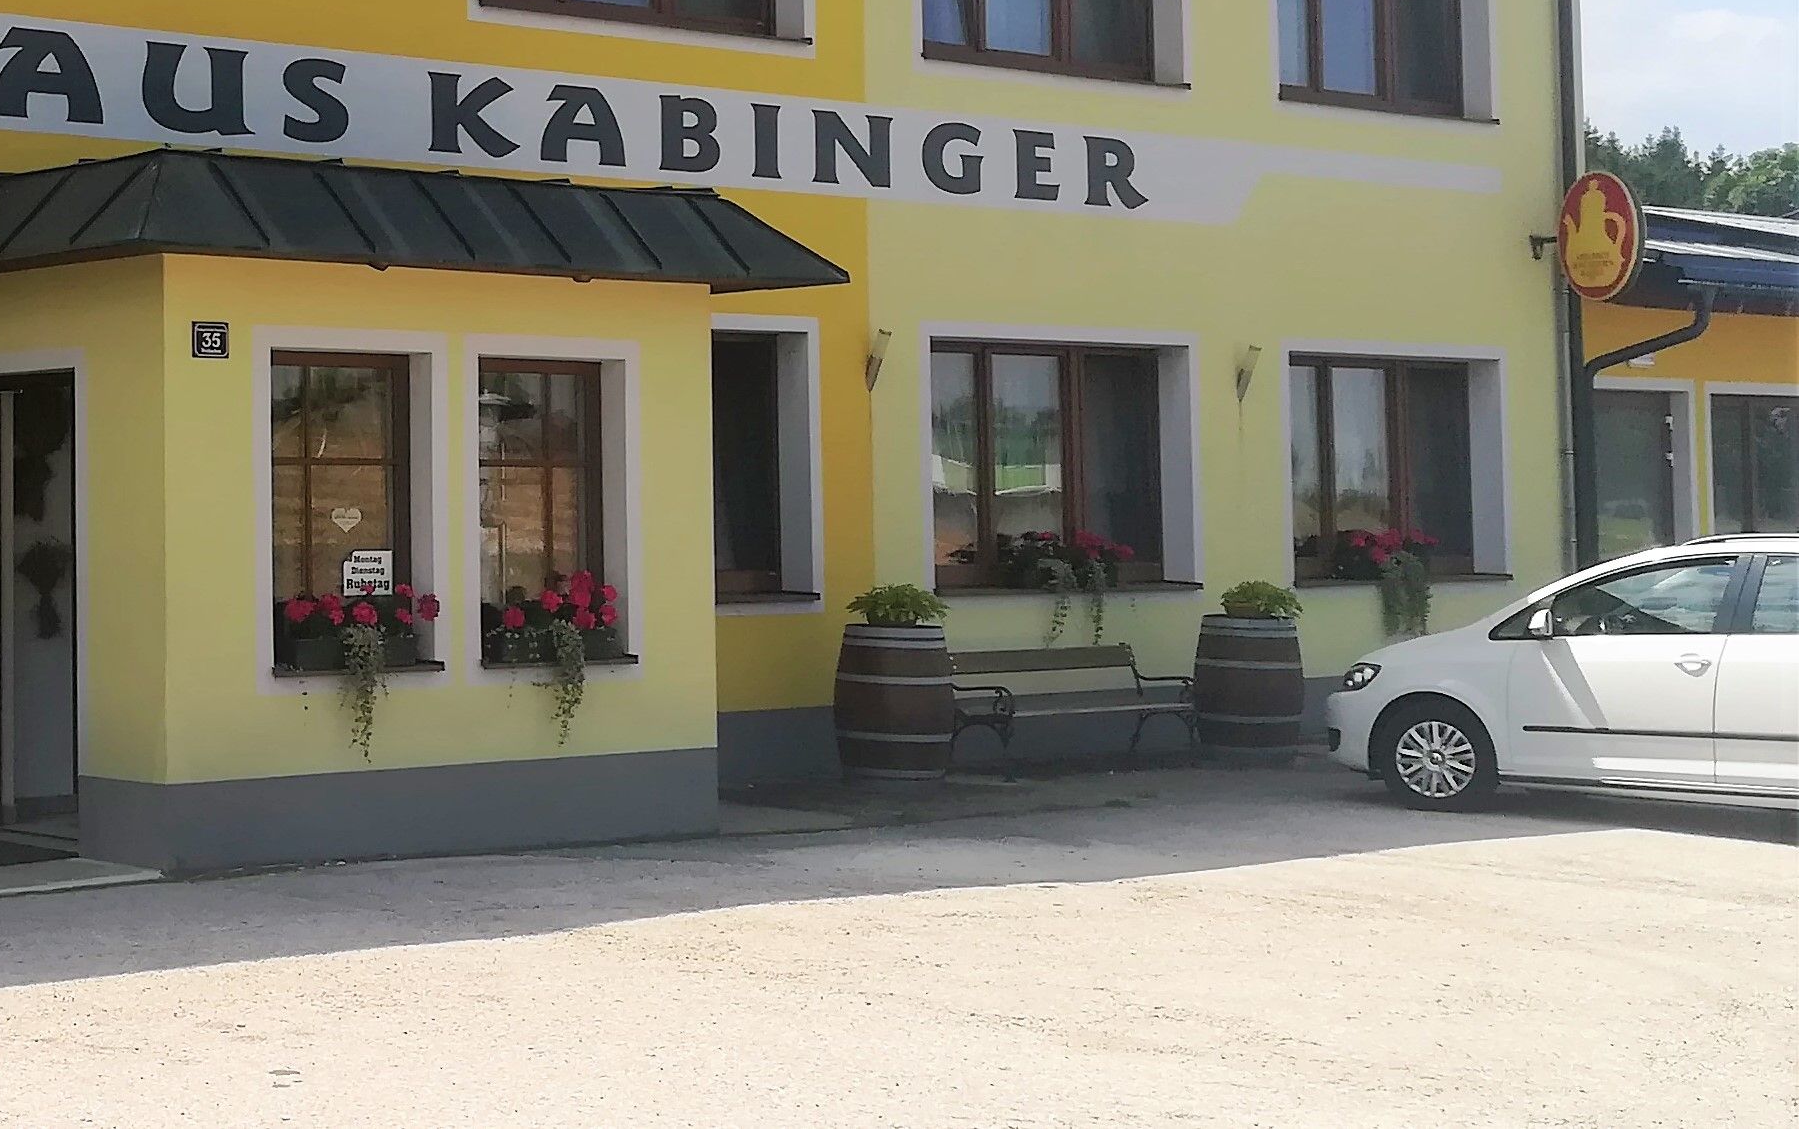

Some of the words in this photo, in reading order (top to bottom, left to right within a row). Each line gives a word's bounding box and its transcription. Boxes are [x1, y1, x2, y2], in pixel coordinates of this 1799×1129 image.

[427, 70, 1149, 210] KABINGER
[201, 332, 221, 348] 35
[353, 555, 382, 564] Montag
[351, 566, 385, 575] Dienstag
